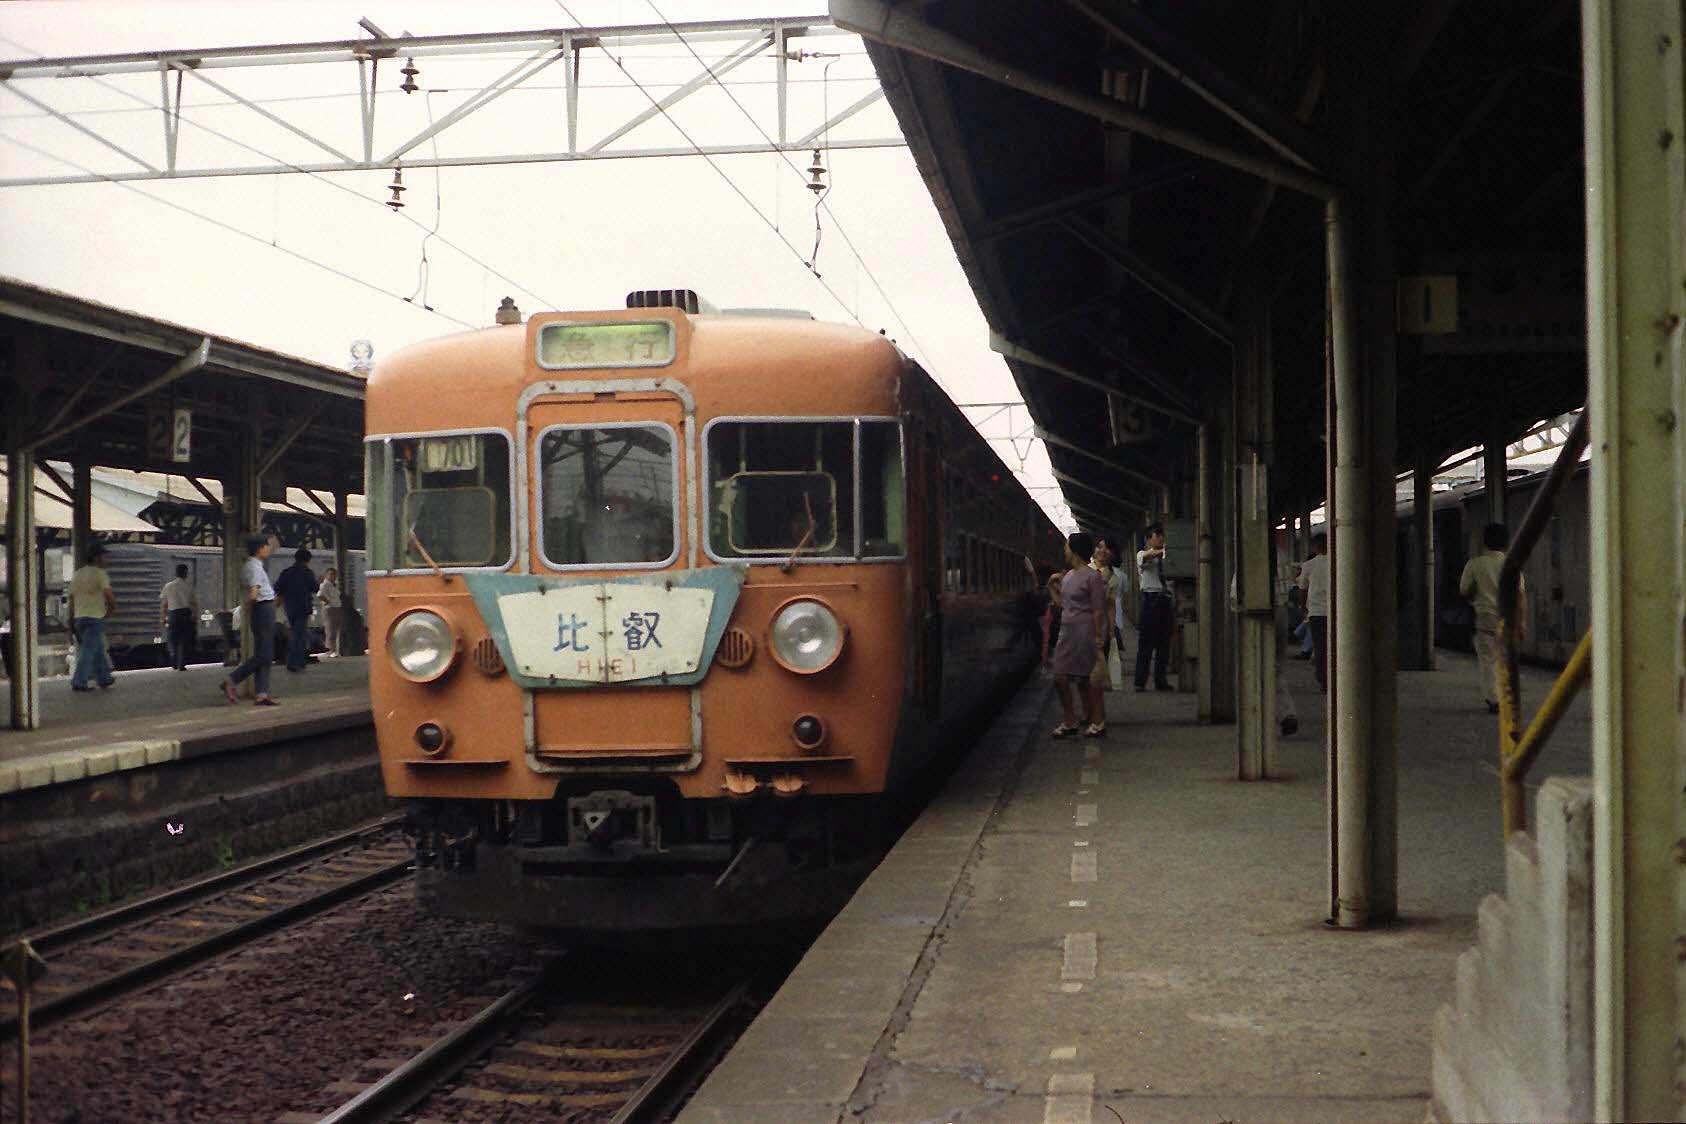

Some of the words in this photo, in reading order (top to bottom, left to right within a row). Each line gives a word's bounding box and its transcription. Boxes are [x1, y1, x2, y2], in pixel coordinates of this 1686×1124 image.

[175, 415, 188, 456] 2
[553, 611, 663, 652] 比叡
[577, 656, 638, 676] HIEI
